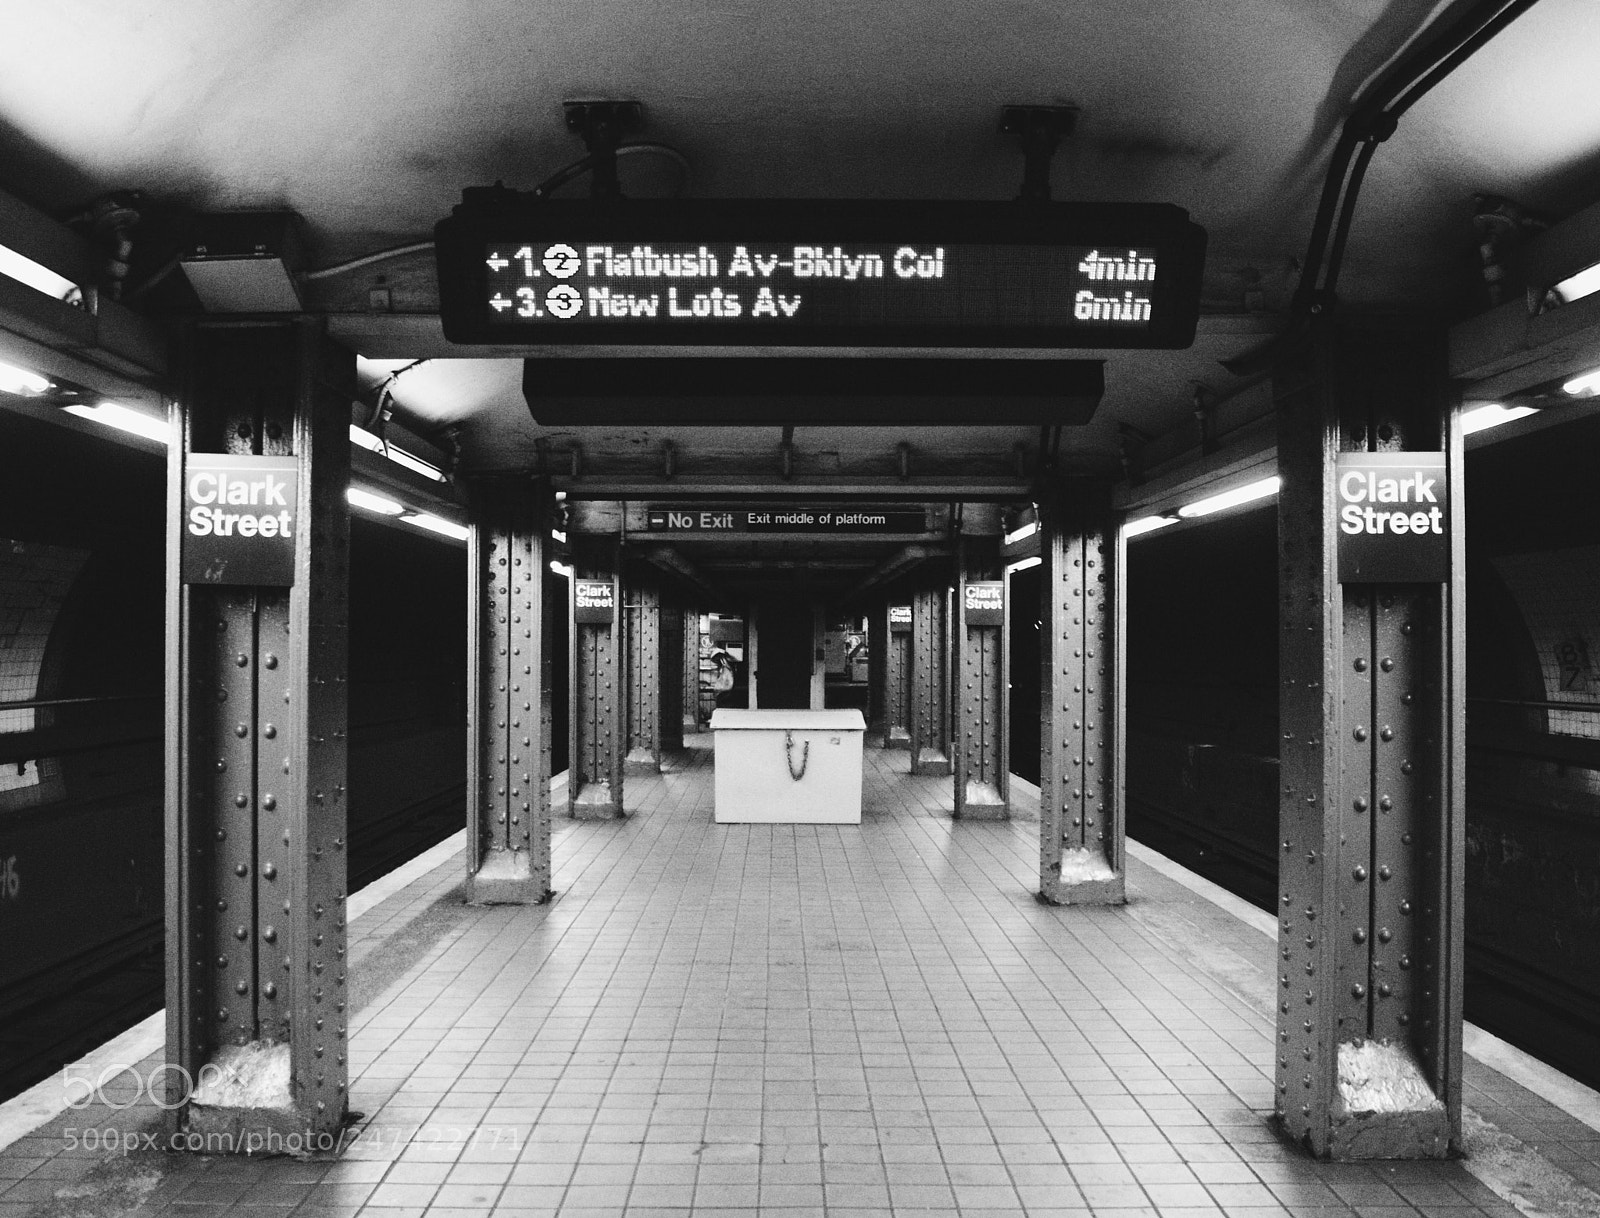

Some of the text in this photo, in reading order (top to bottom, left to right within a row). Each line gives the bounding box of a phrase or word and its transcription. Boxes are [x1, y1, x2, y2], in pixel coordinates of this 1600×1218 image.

[586, 246, 718, 278] Flatbush
[728, 246, 883, 280] Av-Bklyn
[1078, 249, 1157, 281] 4min
[516, 286, 544, 318] 3.
[588, 286, 659, 317] New
[668, 286, 742, 317] Lots
[751, 286, 802, 318] Av
[1074, 290, 1152, 321] 6min
[189, 472, 288, 506] Clark
[1339, 470, 1438, 503] Clark
[188, 505, 292, 538] Street
[667, 512, 734, 529] No Exit
[747, 512, 886, 527] Exit middle of platform
[1340, 504, 1443, 535] Street
[576, 584, 612, 597] Clark
[576, 596, 614, 608] Street
[965, 586, 1001, 599] Clark
[965, 598, 1003, 610] Street
